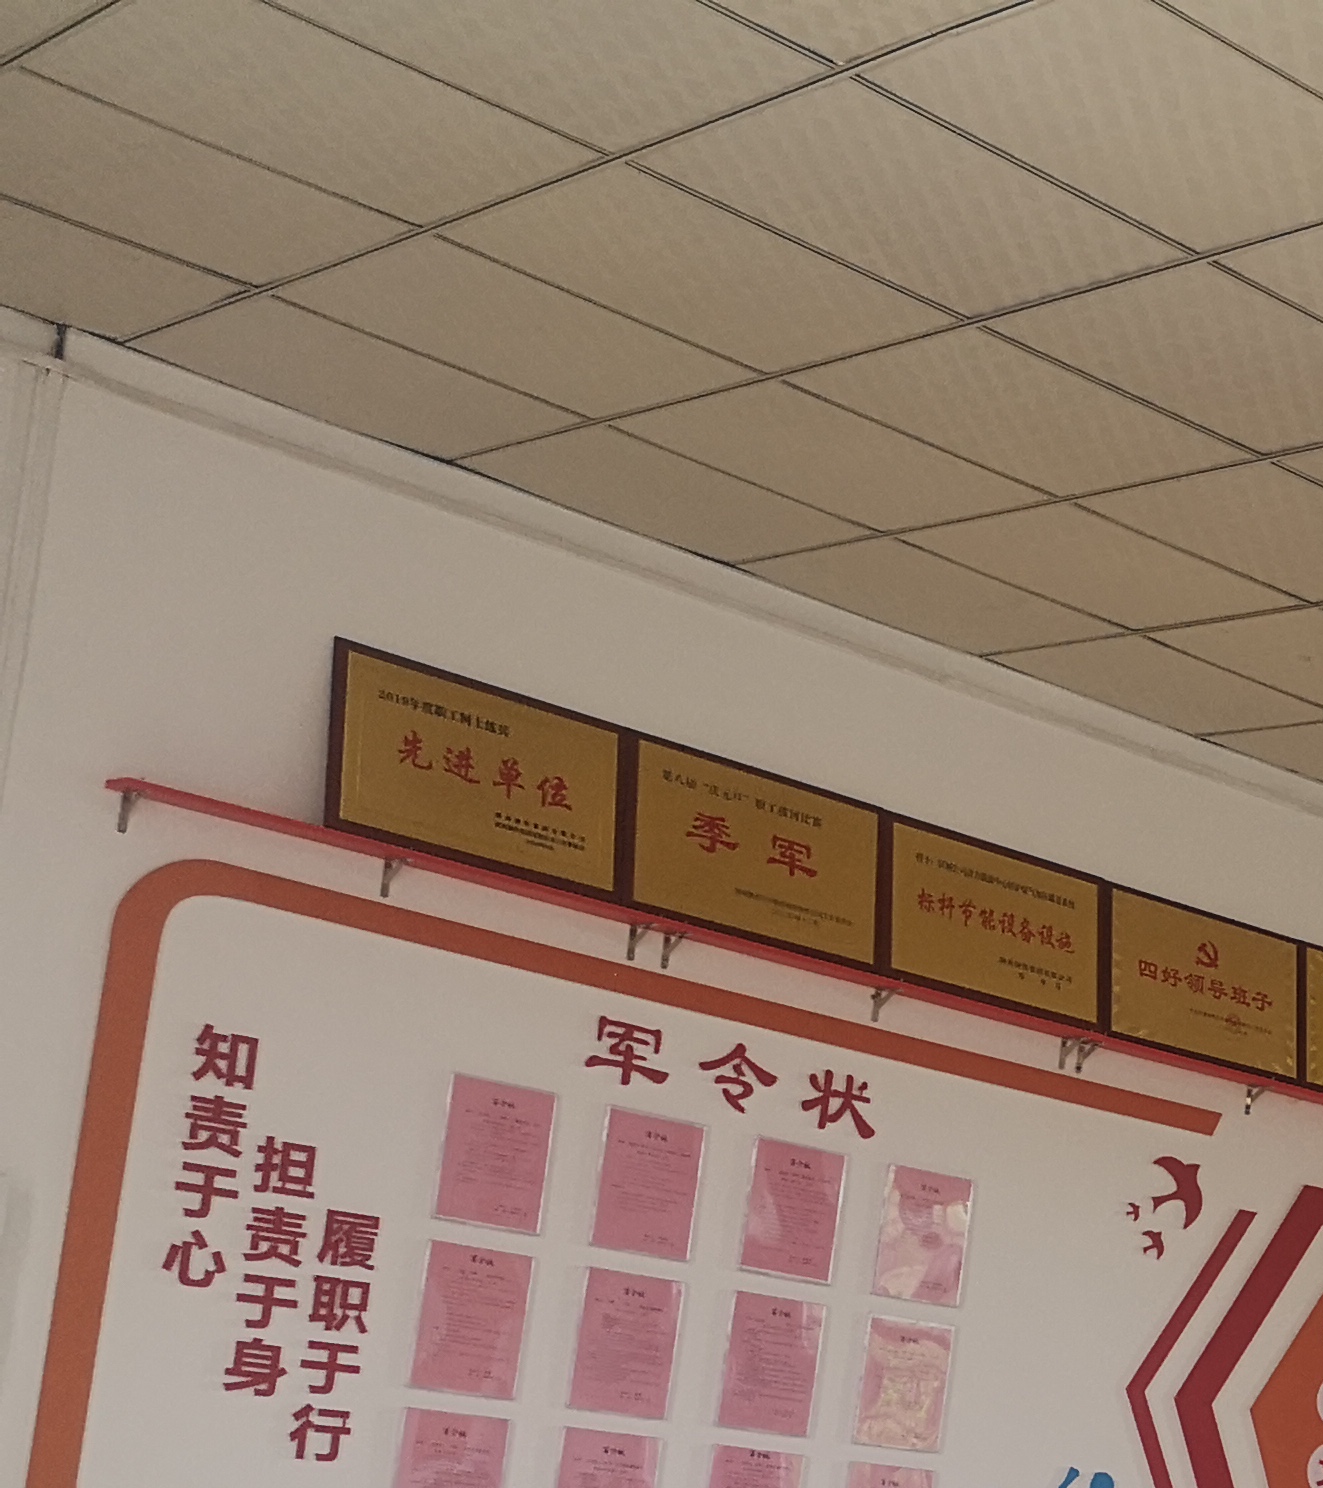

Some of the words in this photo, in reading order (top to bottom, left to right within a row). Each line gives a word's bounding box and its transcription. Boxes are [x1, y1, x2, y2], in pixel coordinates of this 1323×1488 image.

[397, 730, 573, 812] 先进单位
[685, 811, 818, 878] 季军
[916, 888, 1076, 955] 标杆节能设备设施
[1138, 959, 1273, 1012] 四好领导班子
[585, 1015, 875, 1139] 军令状
[162, 1023, 260, 1291] 知责于心
[223, 1136, 317, 1398] 担责于身
[288, 1209, 381, 1463] 履职于行
